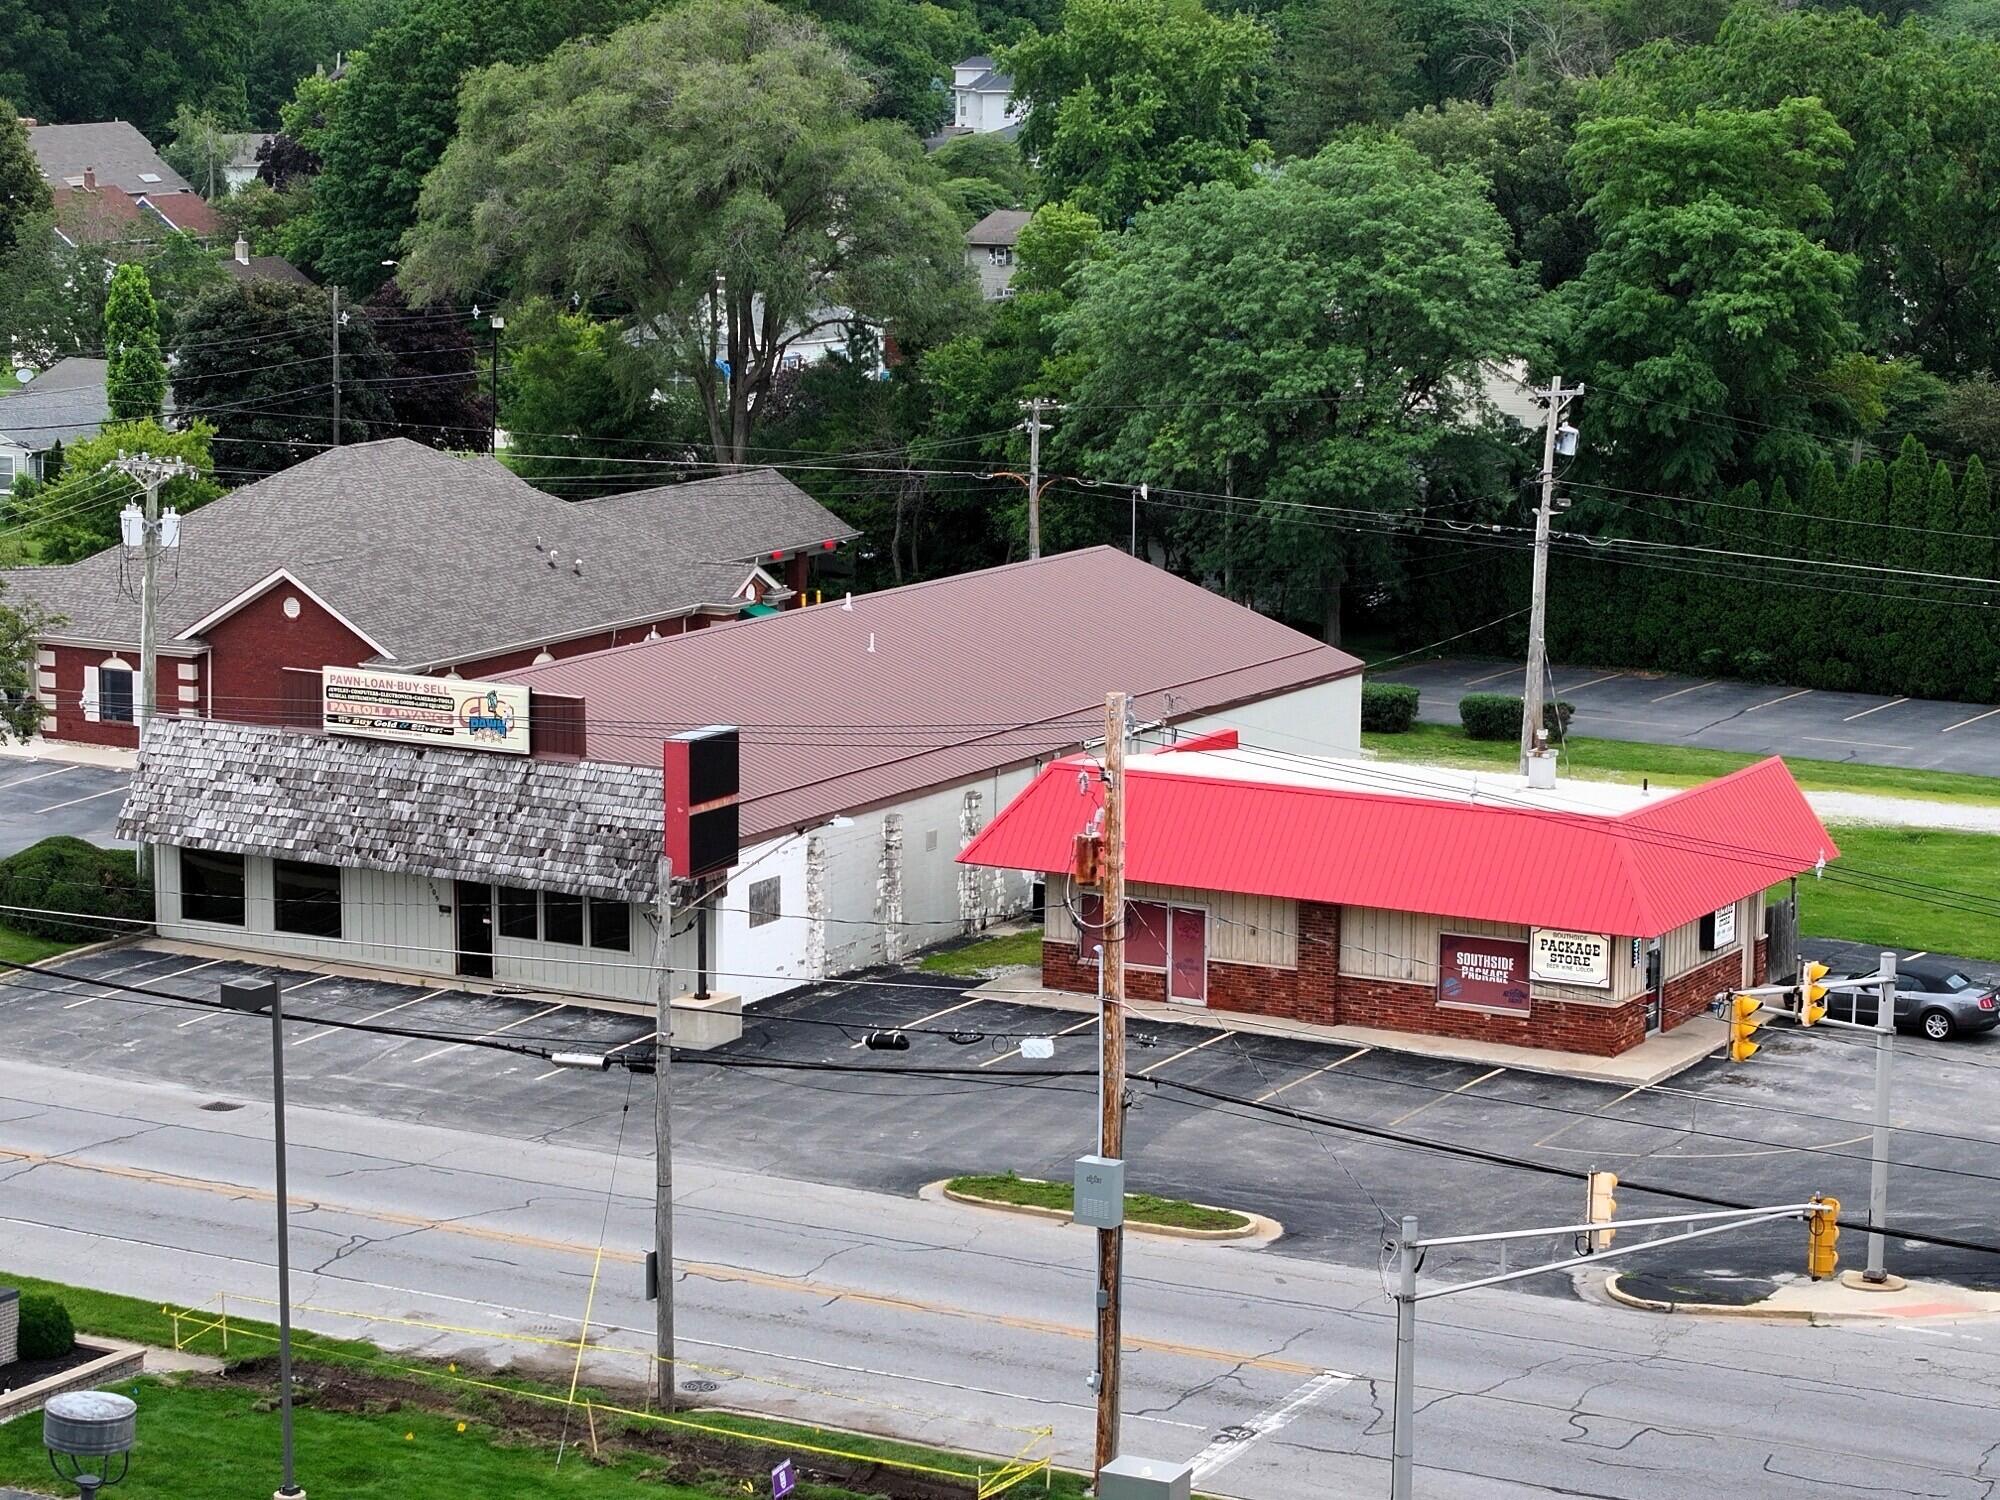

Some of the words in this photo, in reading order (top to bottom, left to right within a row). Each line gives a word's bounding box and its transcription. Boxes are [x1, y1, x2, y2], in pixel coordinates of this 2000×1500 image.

[329, 701, 387, 716] PAYROLL
[388, 707, 451, 724] ADVANCE
[338, 715, 351, 724] We
[352, 717, 372, 727] Buy
[374, 718, 398, 729] Gold
[1552, 932, 1588, 942] SOUTHSIDE
[1540, 938, 1601, 957] PACKAGE
[1456, 951, 1515, 971] SOUTHSIDE
[1550, 953, 1591, 967] STORE
[1461, 965, 1509, 984] PACKAGE
